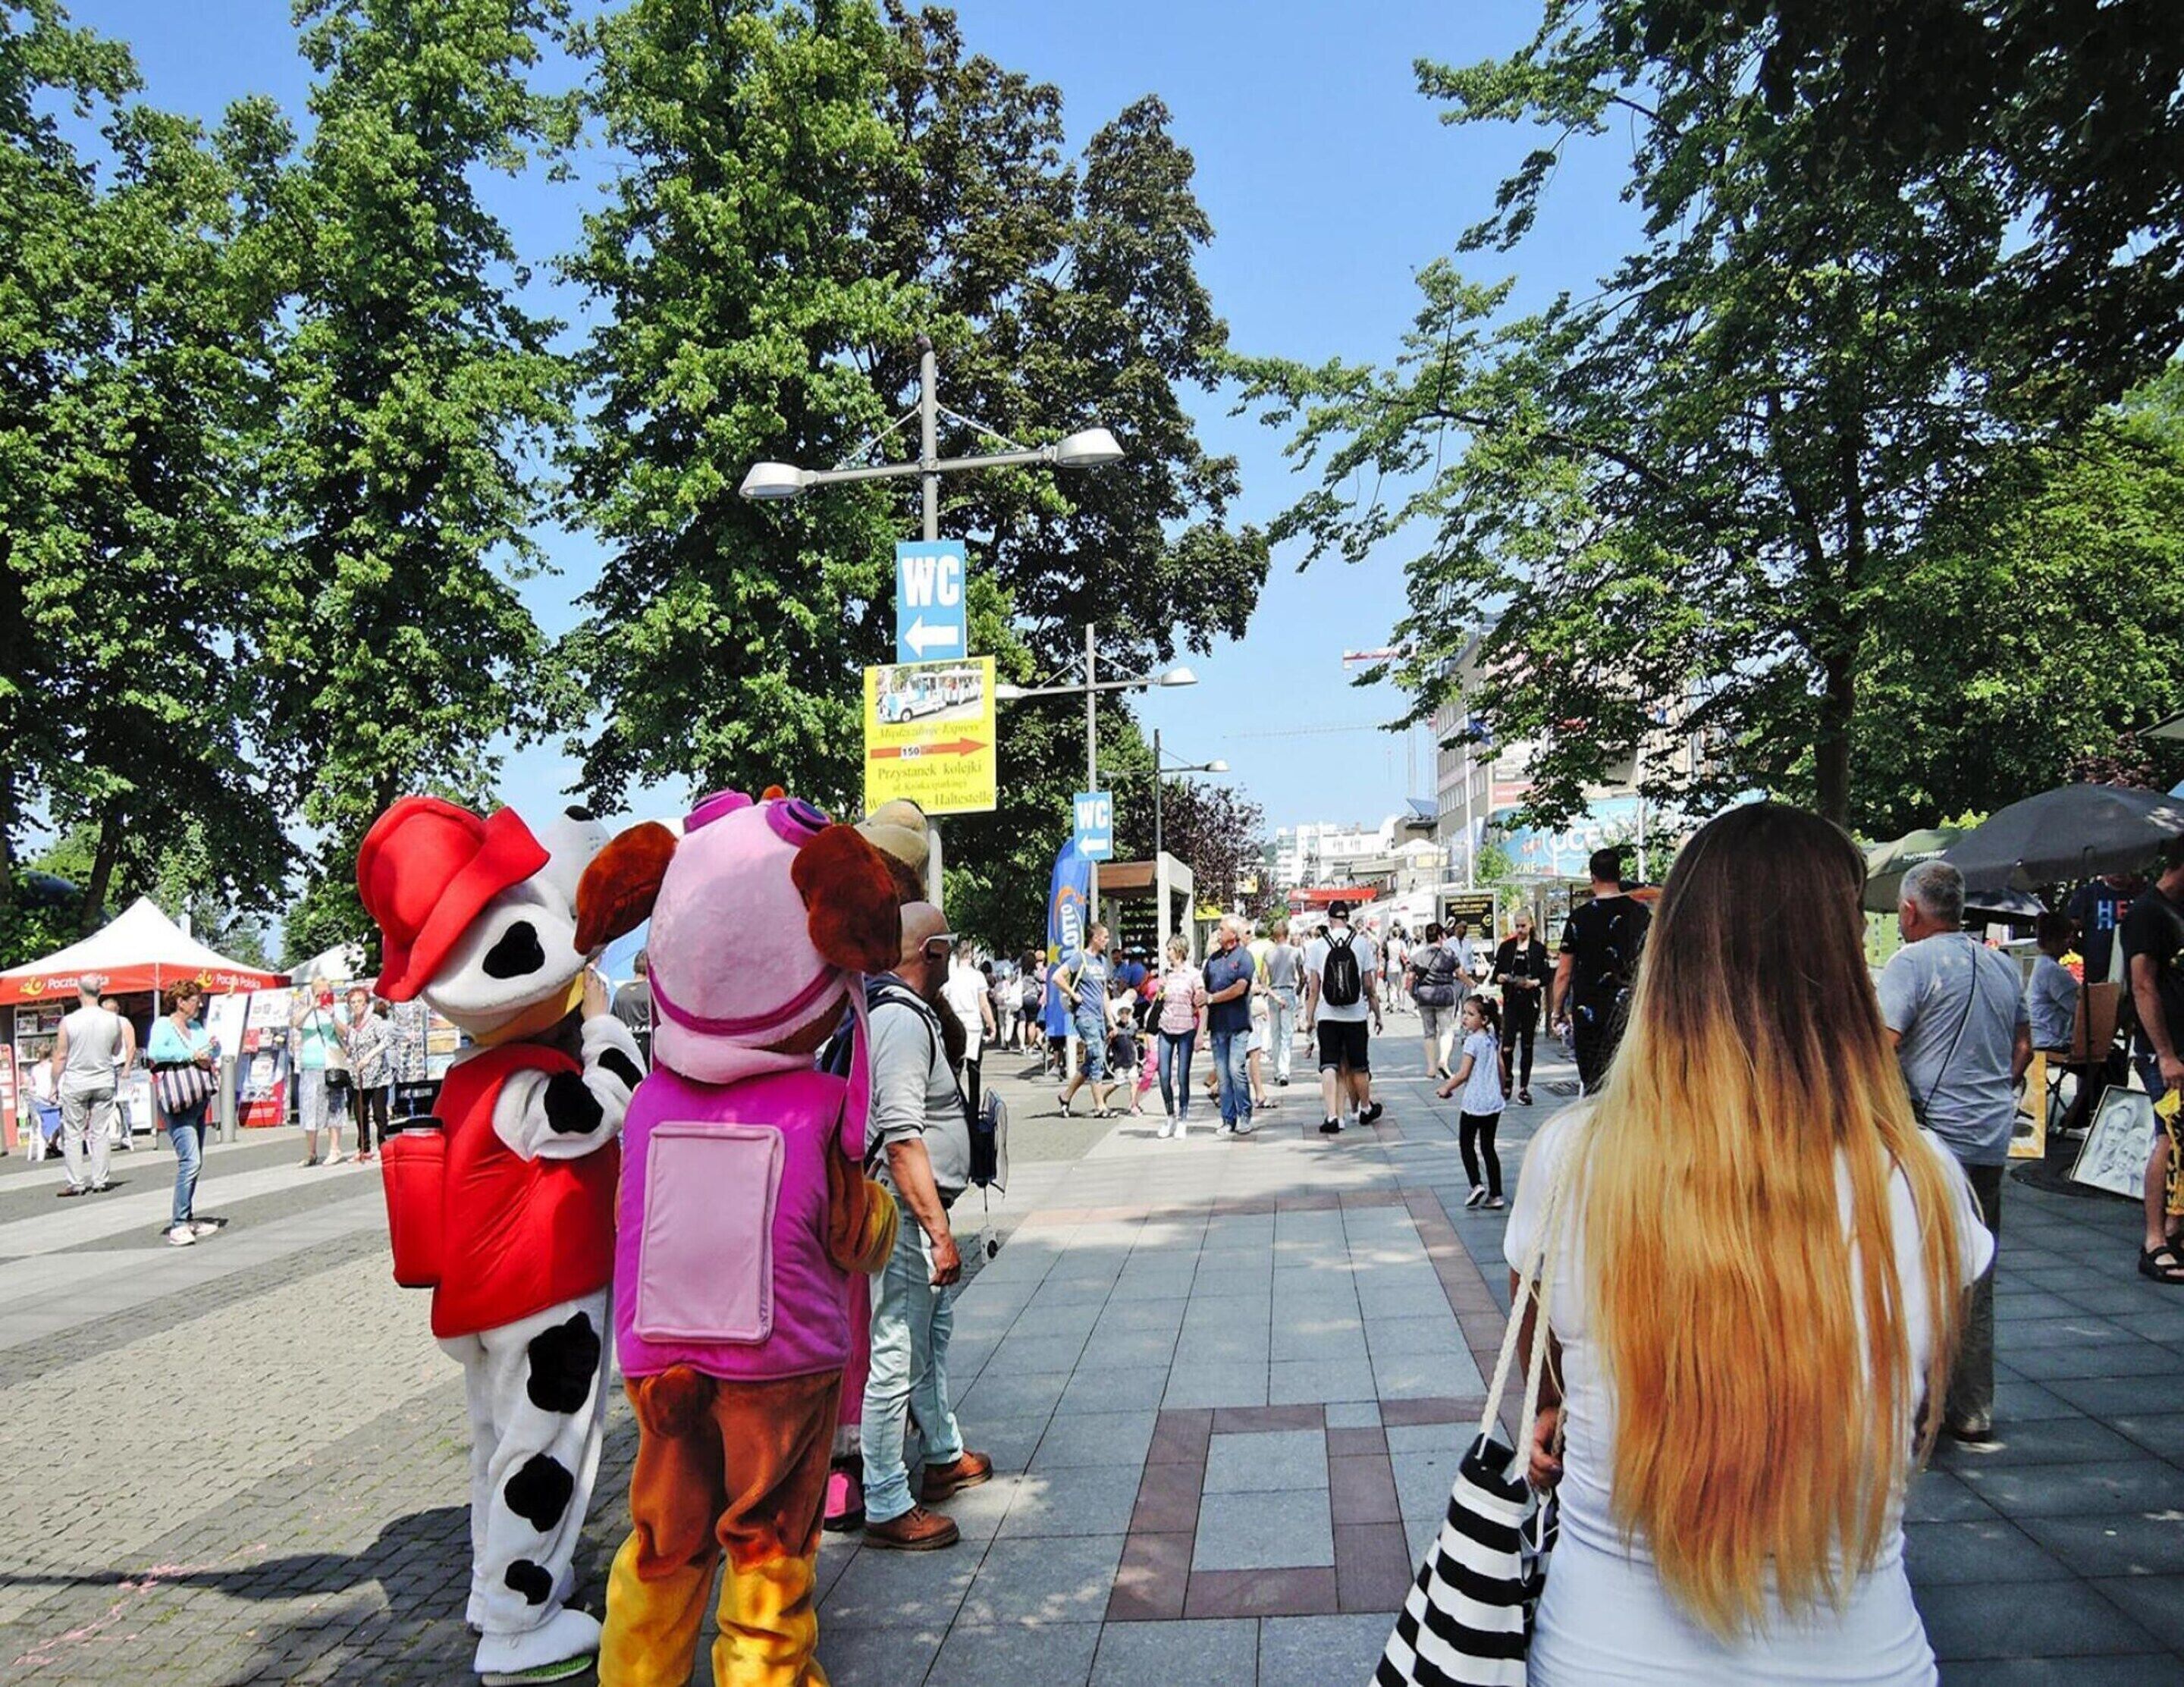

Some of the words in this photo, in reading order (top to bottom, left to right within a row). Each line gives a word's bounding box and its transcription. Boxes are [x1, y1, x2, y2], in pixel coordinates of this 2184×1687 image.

[902, 554, 960, 607] WC
[902, 747, 920, 756] 150
[878, 764, 937, 781] Przystanek
[943, 760, 982, 775] kolejki
[935, 792, 993, 806] Haltestelle
[1077, 800, 1109, 830] WC
